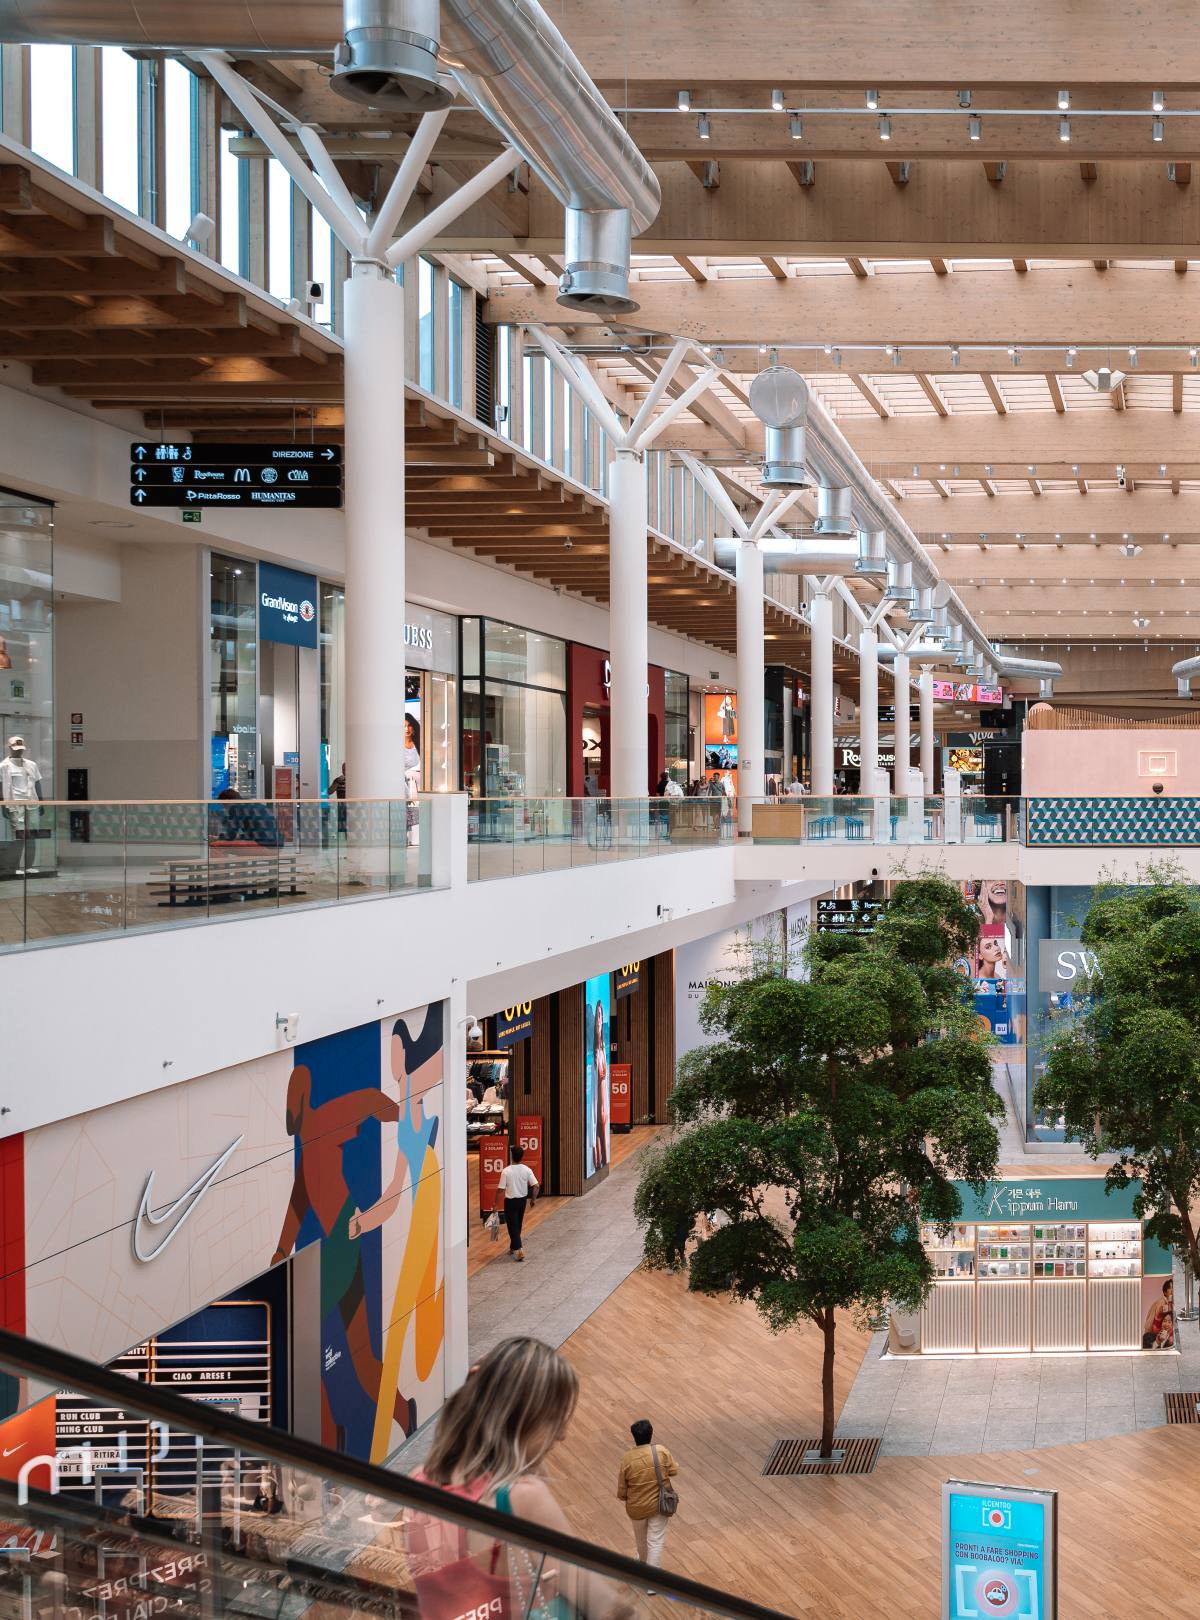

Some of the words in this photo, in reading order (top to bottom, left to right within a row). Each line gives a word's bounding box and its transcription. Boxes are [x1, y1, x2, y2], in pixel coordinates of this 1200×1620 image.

[272, 451, 314, 459] DIREZIONE
[197, 492, 241, 500] PittaRosso
[251, 492, 296, 500] HUMANITAS
[261, 592, 299, 614] GrandVision
[403, 623, 433, 650] UESS
[1047, 1197, 1079, 1211] Haru
[172, 1372, 193, 1381] CIAO
[200, 1372, 225, 1380] ARESE
[60, 1412, 78, 1421] RUN
[80, 1412, 101, 1420] CLUB
[117, 1412, 125, 1420] &
[56, 1425, 81, 1433] INING
[83, 1425, 104, 1433] CLUB
[955, 1542, 979, 1553] PRONTI
[986, 1547, 1002, 1555] FARE
[1004, 1548, 1039, 1560] SHOPPING
[955, 1551, 969, 1559] CON
